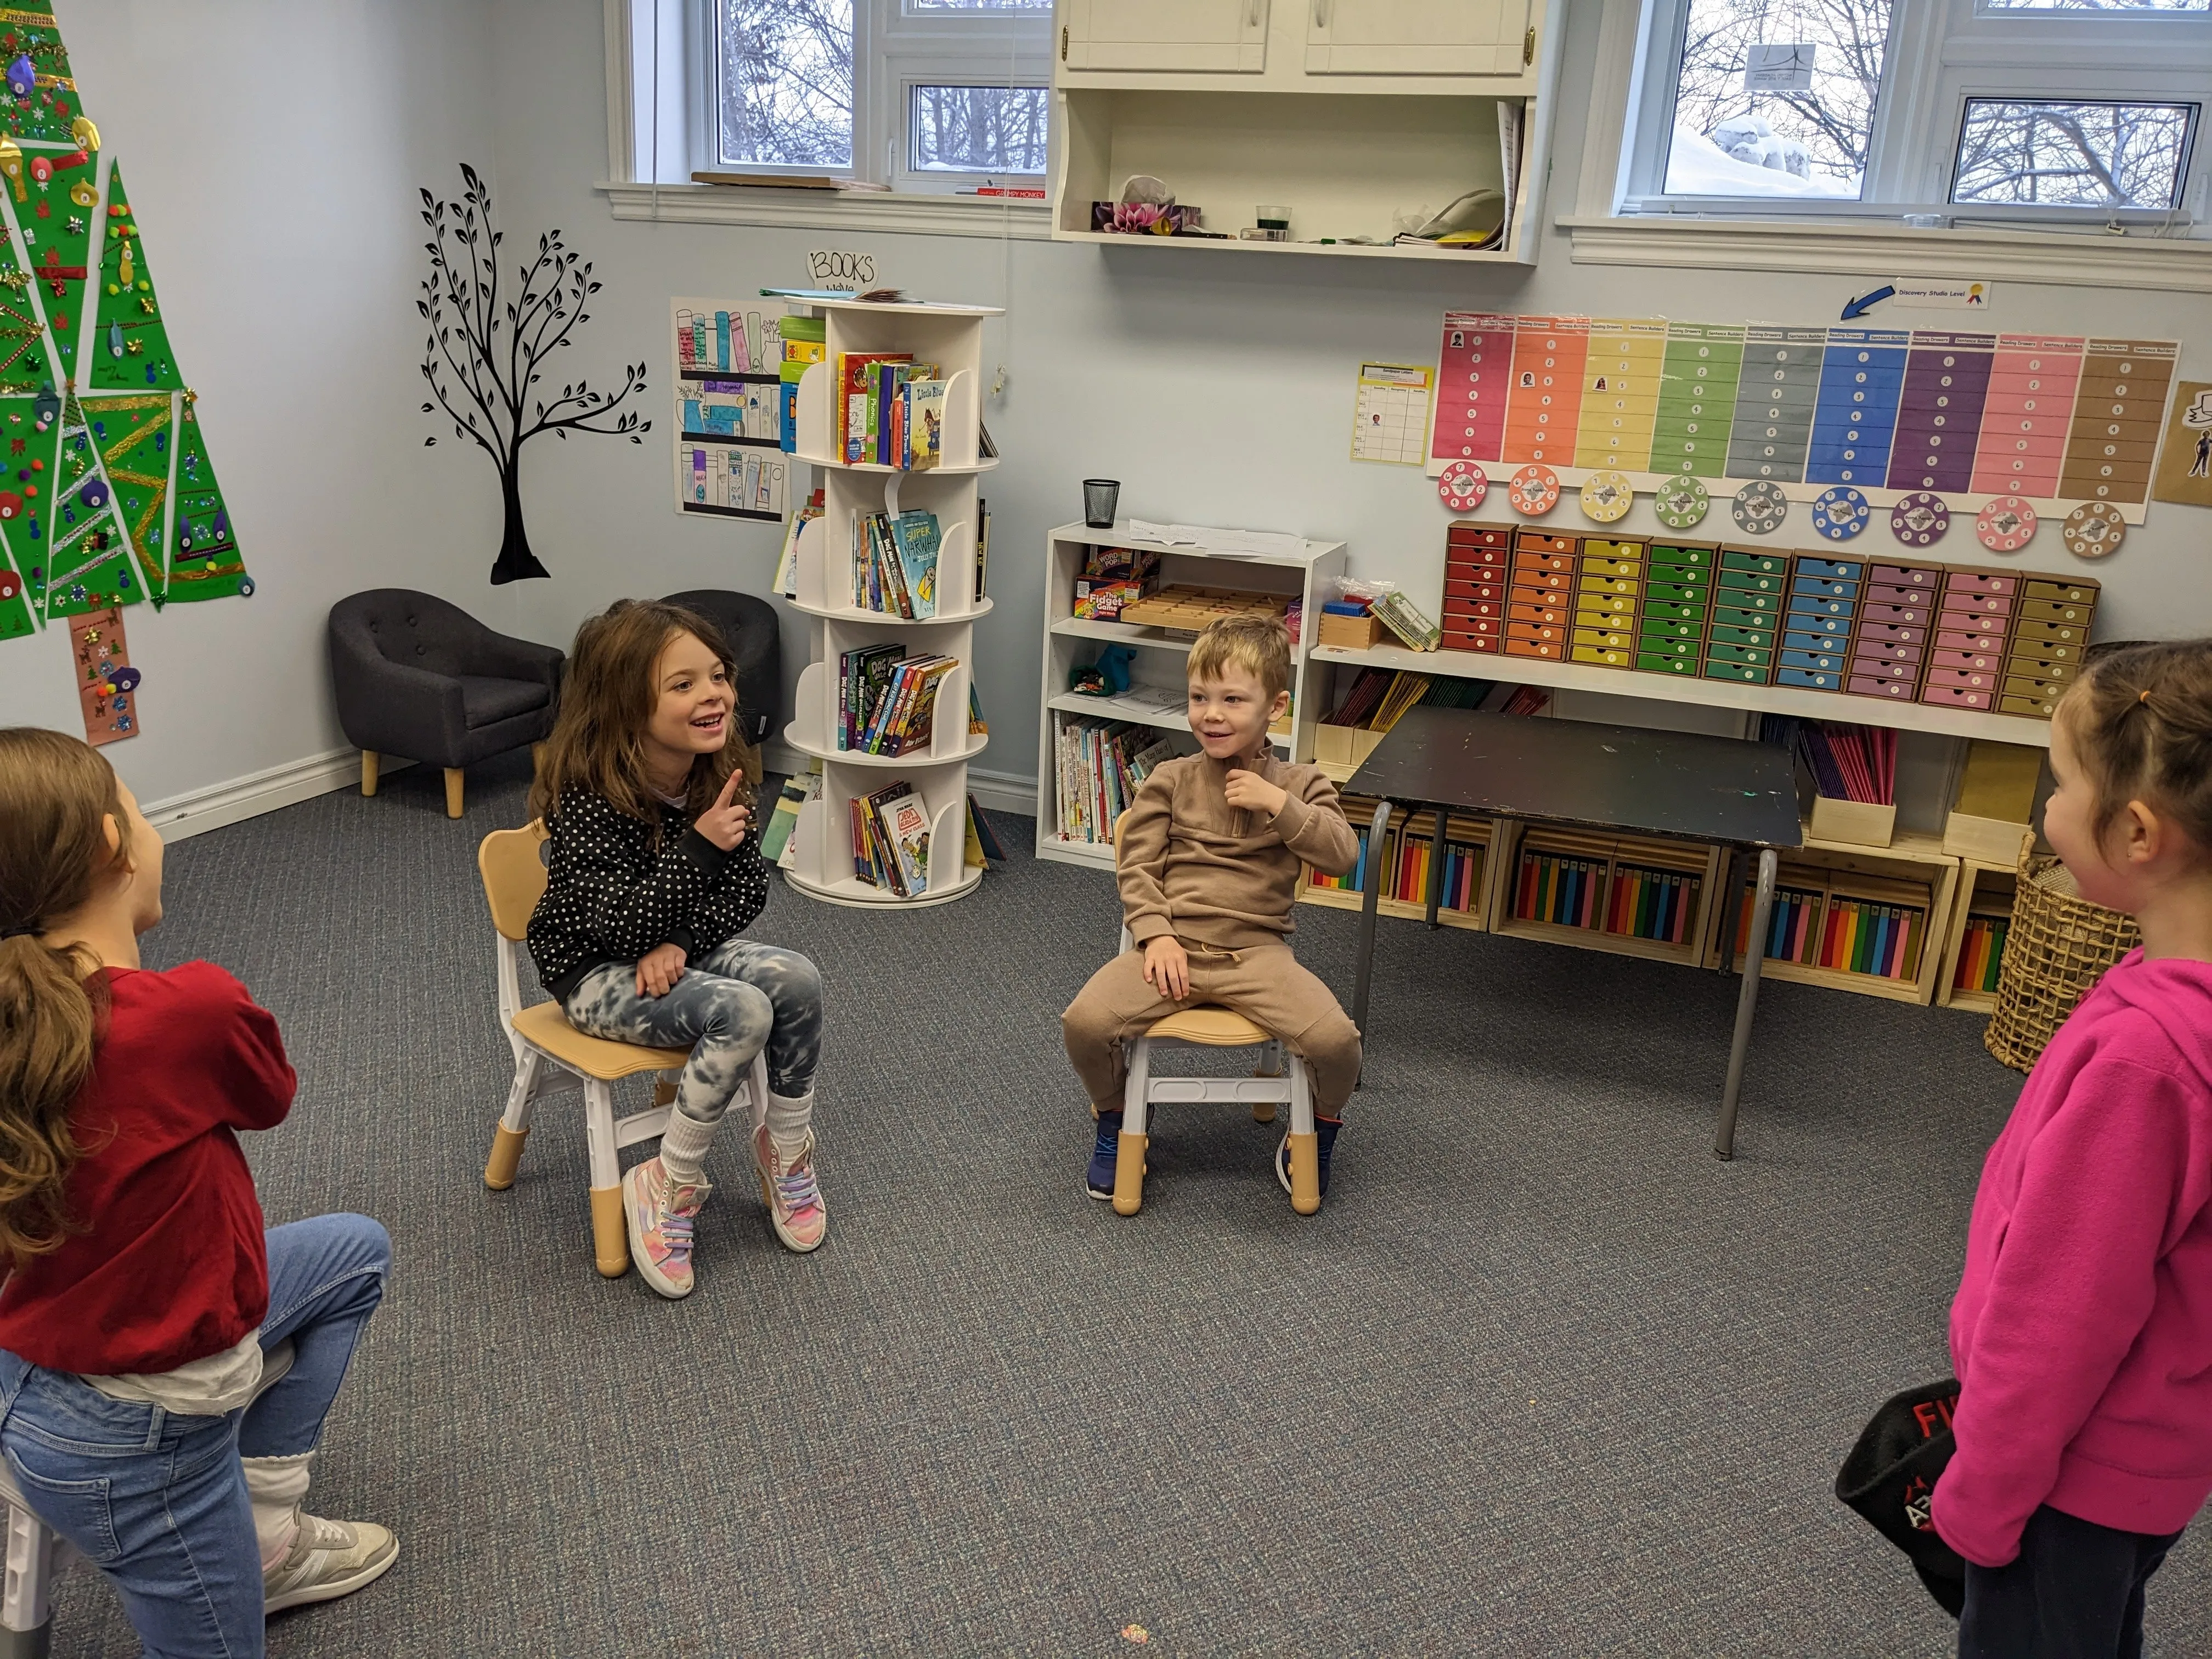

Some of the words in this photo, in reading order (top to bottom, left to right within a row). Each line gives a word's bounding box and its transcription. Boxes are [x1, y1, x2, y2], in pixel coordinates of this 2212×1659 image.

[810, 252, 874, 284] BOOKS
[917, 388, 932, 400] Little
[933, 386, 944, 397] Blue
[906, 527, 932, 541] SUPER
[883, 538, 891, 551] DOG
[904, 534, 939, 558] NARWHAL
[886, 550, 895, 562] MAN
[917, 554, 929, 562] JELLY
[1099, 552, 1118, 563] WORD
[1142, 552, 1154, 566] WORD
[1105, 559, 1120, 567] POP!
[1090, 594, 1122, 606] Fidget
[1097, 603, 1118, 611] Game
[871, 658, 886, 675] DOG
[926, 675, 939, 690] DOG
[881, 684, 889, 695] DOG
[909, 690, 917, 699] DOG
[878, 695, 886, 706] MAN
[895, 697, 904, 708] MAN
[905, 699, 913, 710] MAN
[900, 809, 913, 821] JEDI
[900, 816, 918, 827] ACADEMY
[913, 822, 925, 831] CLASS
